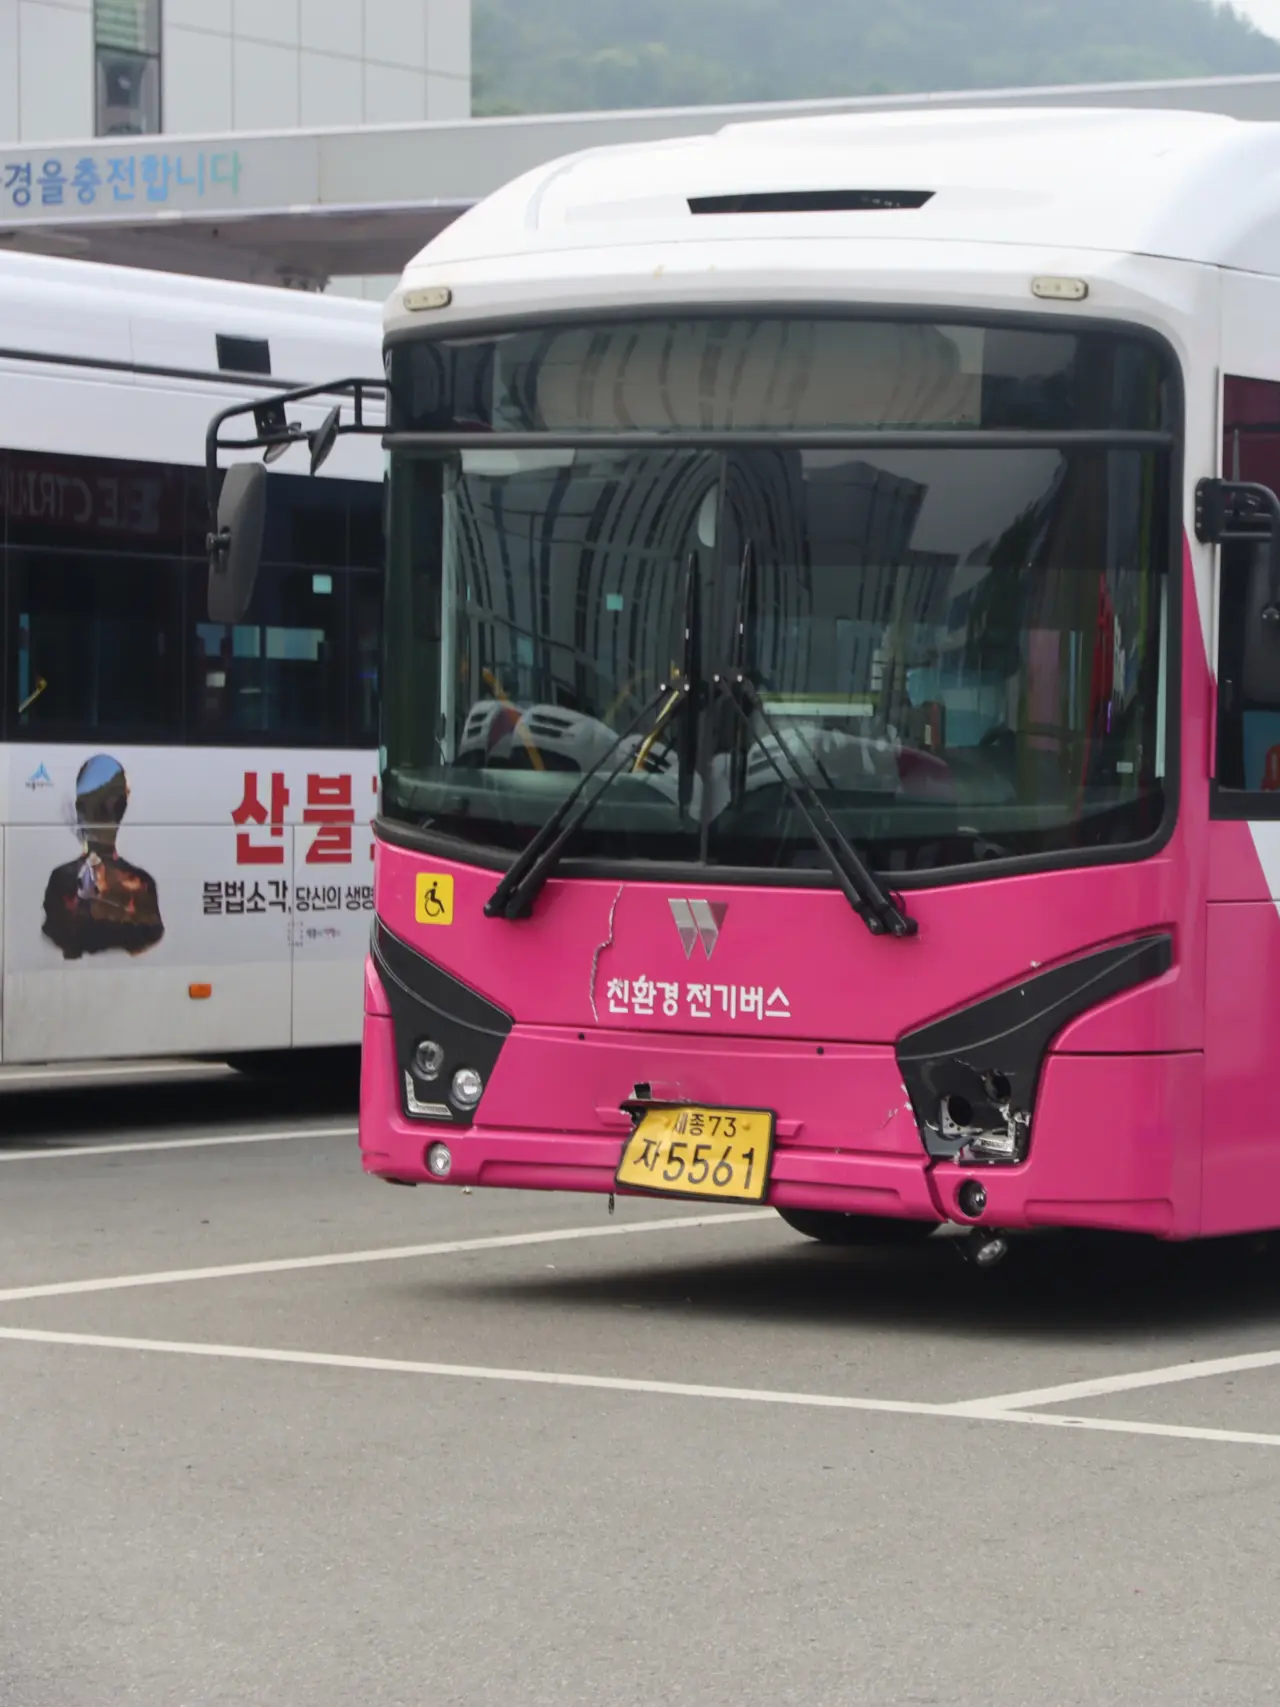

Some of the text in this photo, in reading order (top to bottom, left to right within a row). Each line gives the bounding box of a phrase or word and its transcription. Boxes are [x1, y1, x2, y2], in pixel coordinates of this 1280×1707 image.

[295, 885, 342, 912] 당신의
[606, 974, 792, 1021] 친환경 전기버스
